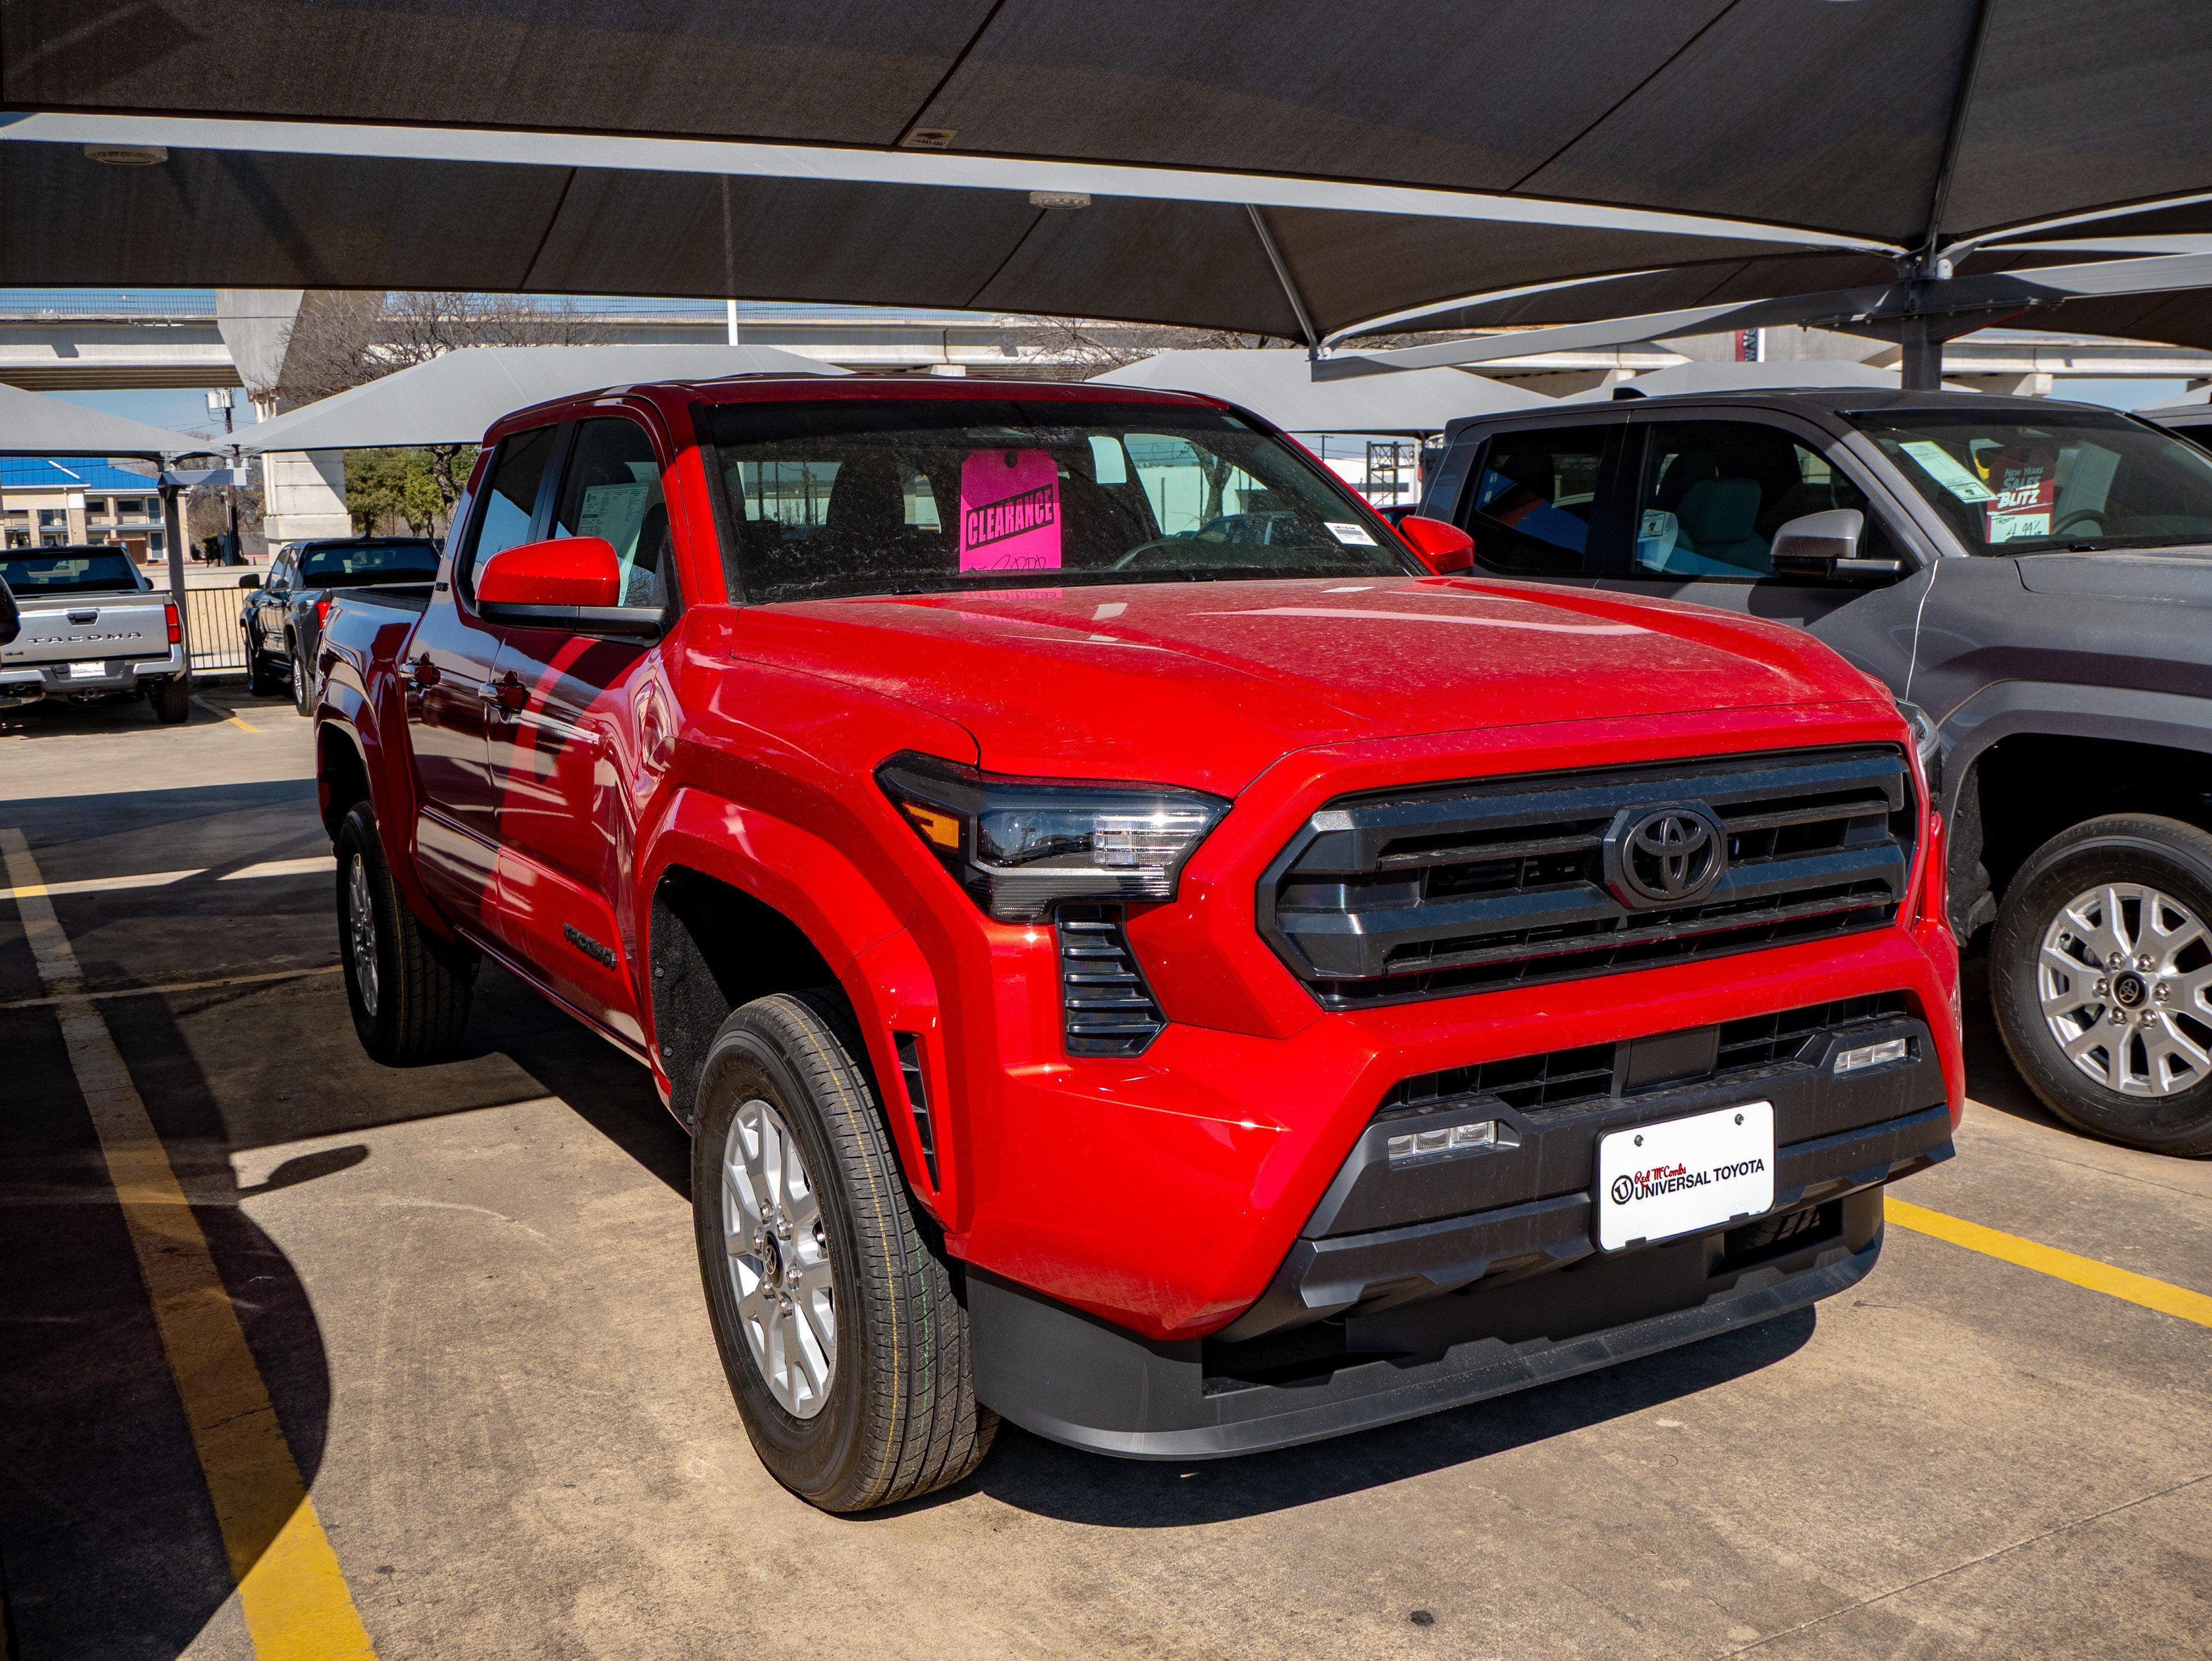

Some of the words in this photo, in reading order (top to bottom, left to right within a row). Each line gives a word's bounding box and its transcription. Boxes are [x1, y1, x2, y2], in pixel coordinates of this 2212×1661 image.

[2001, 476, 2041, 493] SALES
[1997, 489, 2040, 509] BLITZ
[968, 489, 1053, 546] CLEARANCE
[28, 631, 143, 645] TACOMA
[562, 922, 617, 969] TACOMA
[1634, 1170, 1651, 1187] Red
[1635, 1170, 1711, 1201] UNIVERSAL
[1713, 1158, 1765, 1182] TOYOTA
